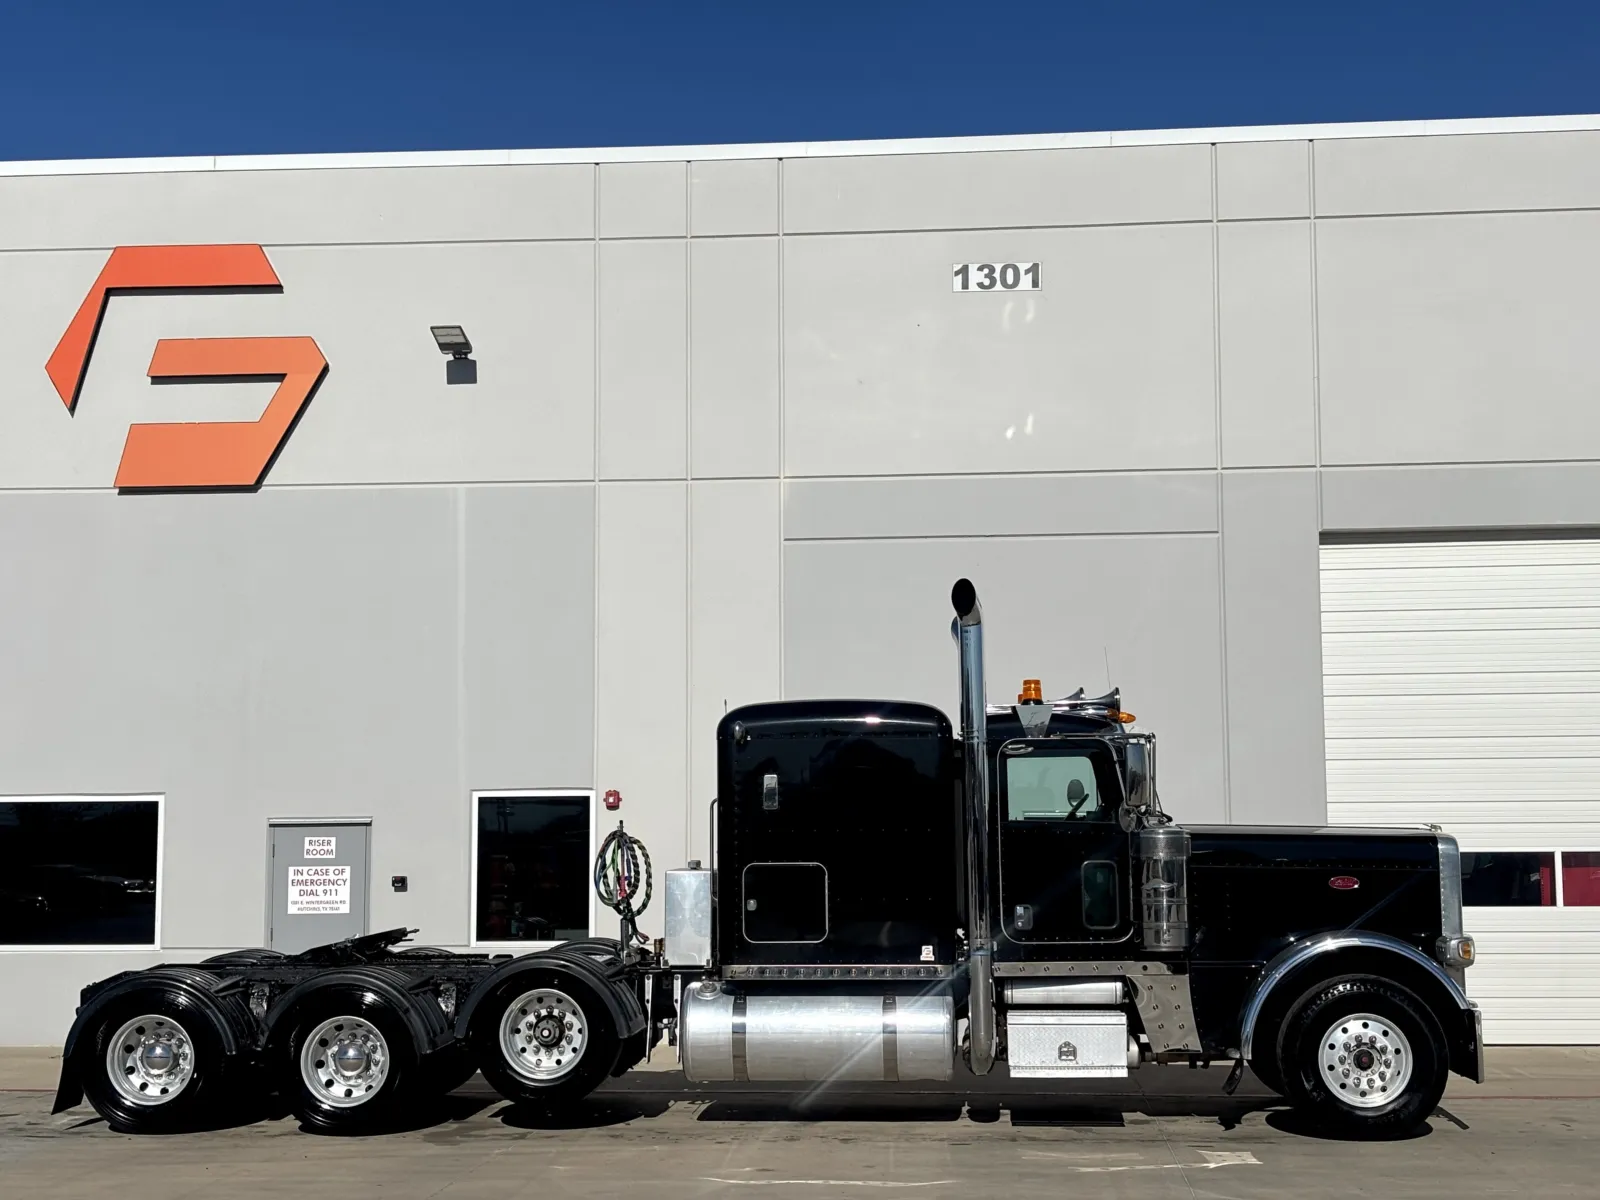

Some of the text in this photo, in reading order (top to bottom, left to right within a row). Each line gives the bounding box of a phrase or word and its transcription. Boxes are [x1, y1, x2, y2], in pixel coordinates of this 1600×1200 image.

[954, 262, 1039, 290] 1301
[308, 839, 332, 847] RISER
[293, 868, 346, 877] IN CASE OF
[291, 878, 348, 887] EMERGENCY
[298, 888, 338, 897] DIAL 911
